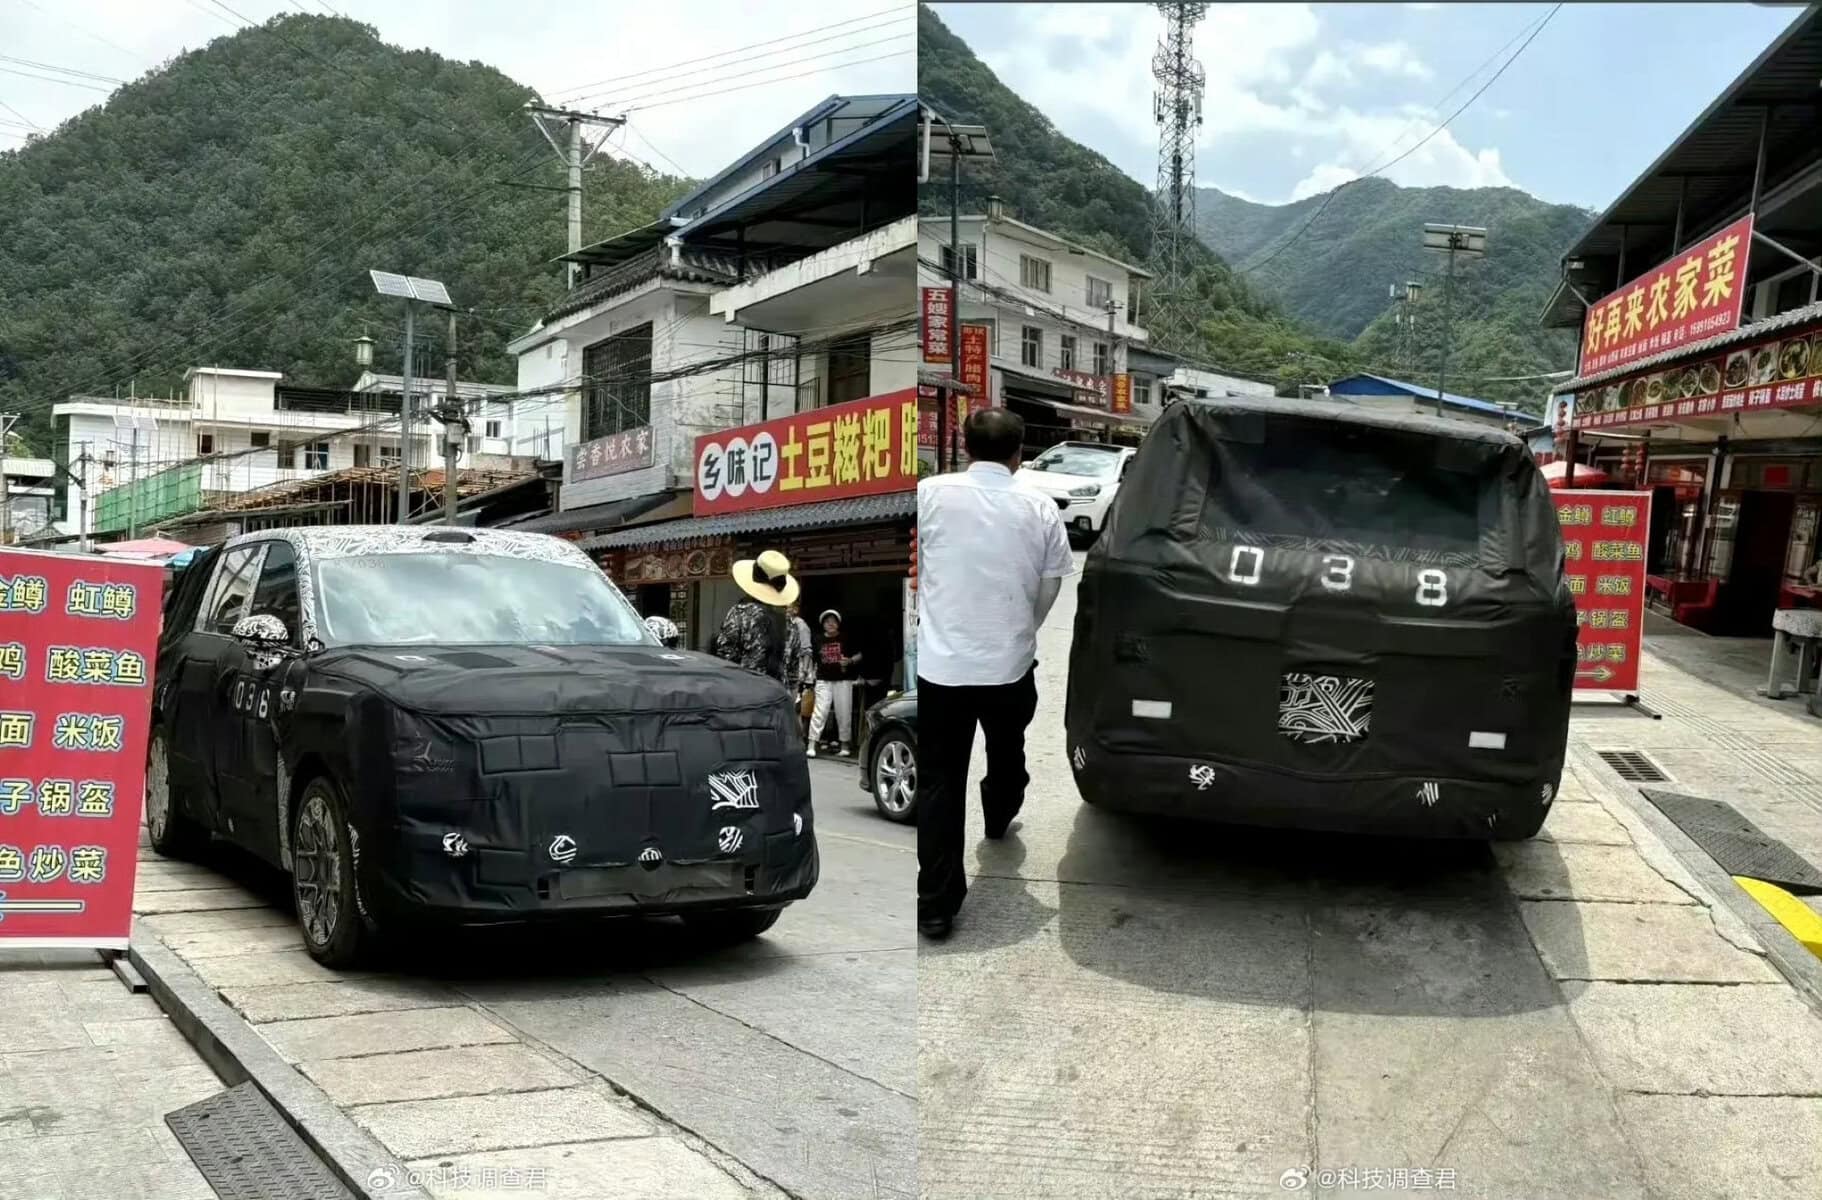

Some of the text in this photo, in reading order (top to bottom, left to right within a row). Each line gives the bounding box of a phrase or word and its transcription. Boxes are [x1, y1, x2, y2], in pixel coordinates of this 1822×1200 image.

[1586, 234, 1739, 354] 好再来农家菜
[702, 442, 773, 490] 乡味记
[779, 407, 892, 491] 土豆糍粑
[1592, 542, 1641, 559] 酸菜鱼
[1230, 545, 1448, 607] 038
[1598, 576, 1631, 595] 米饭
[68, 582, 135, 618] 虹鳟
[48, 648, 145, 685] 酸菜鱼
[0, 713, 122, 751] 面 米饭
